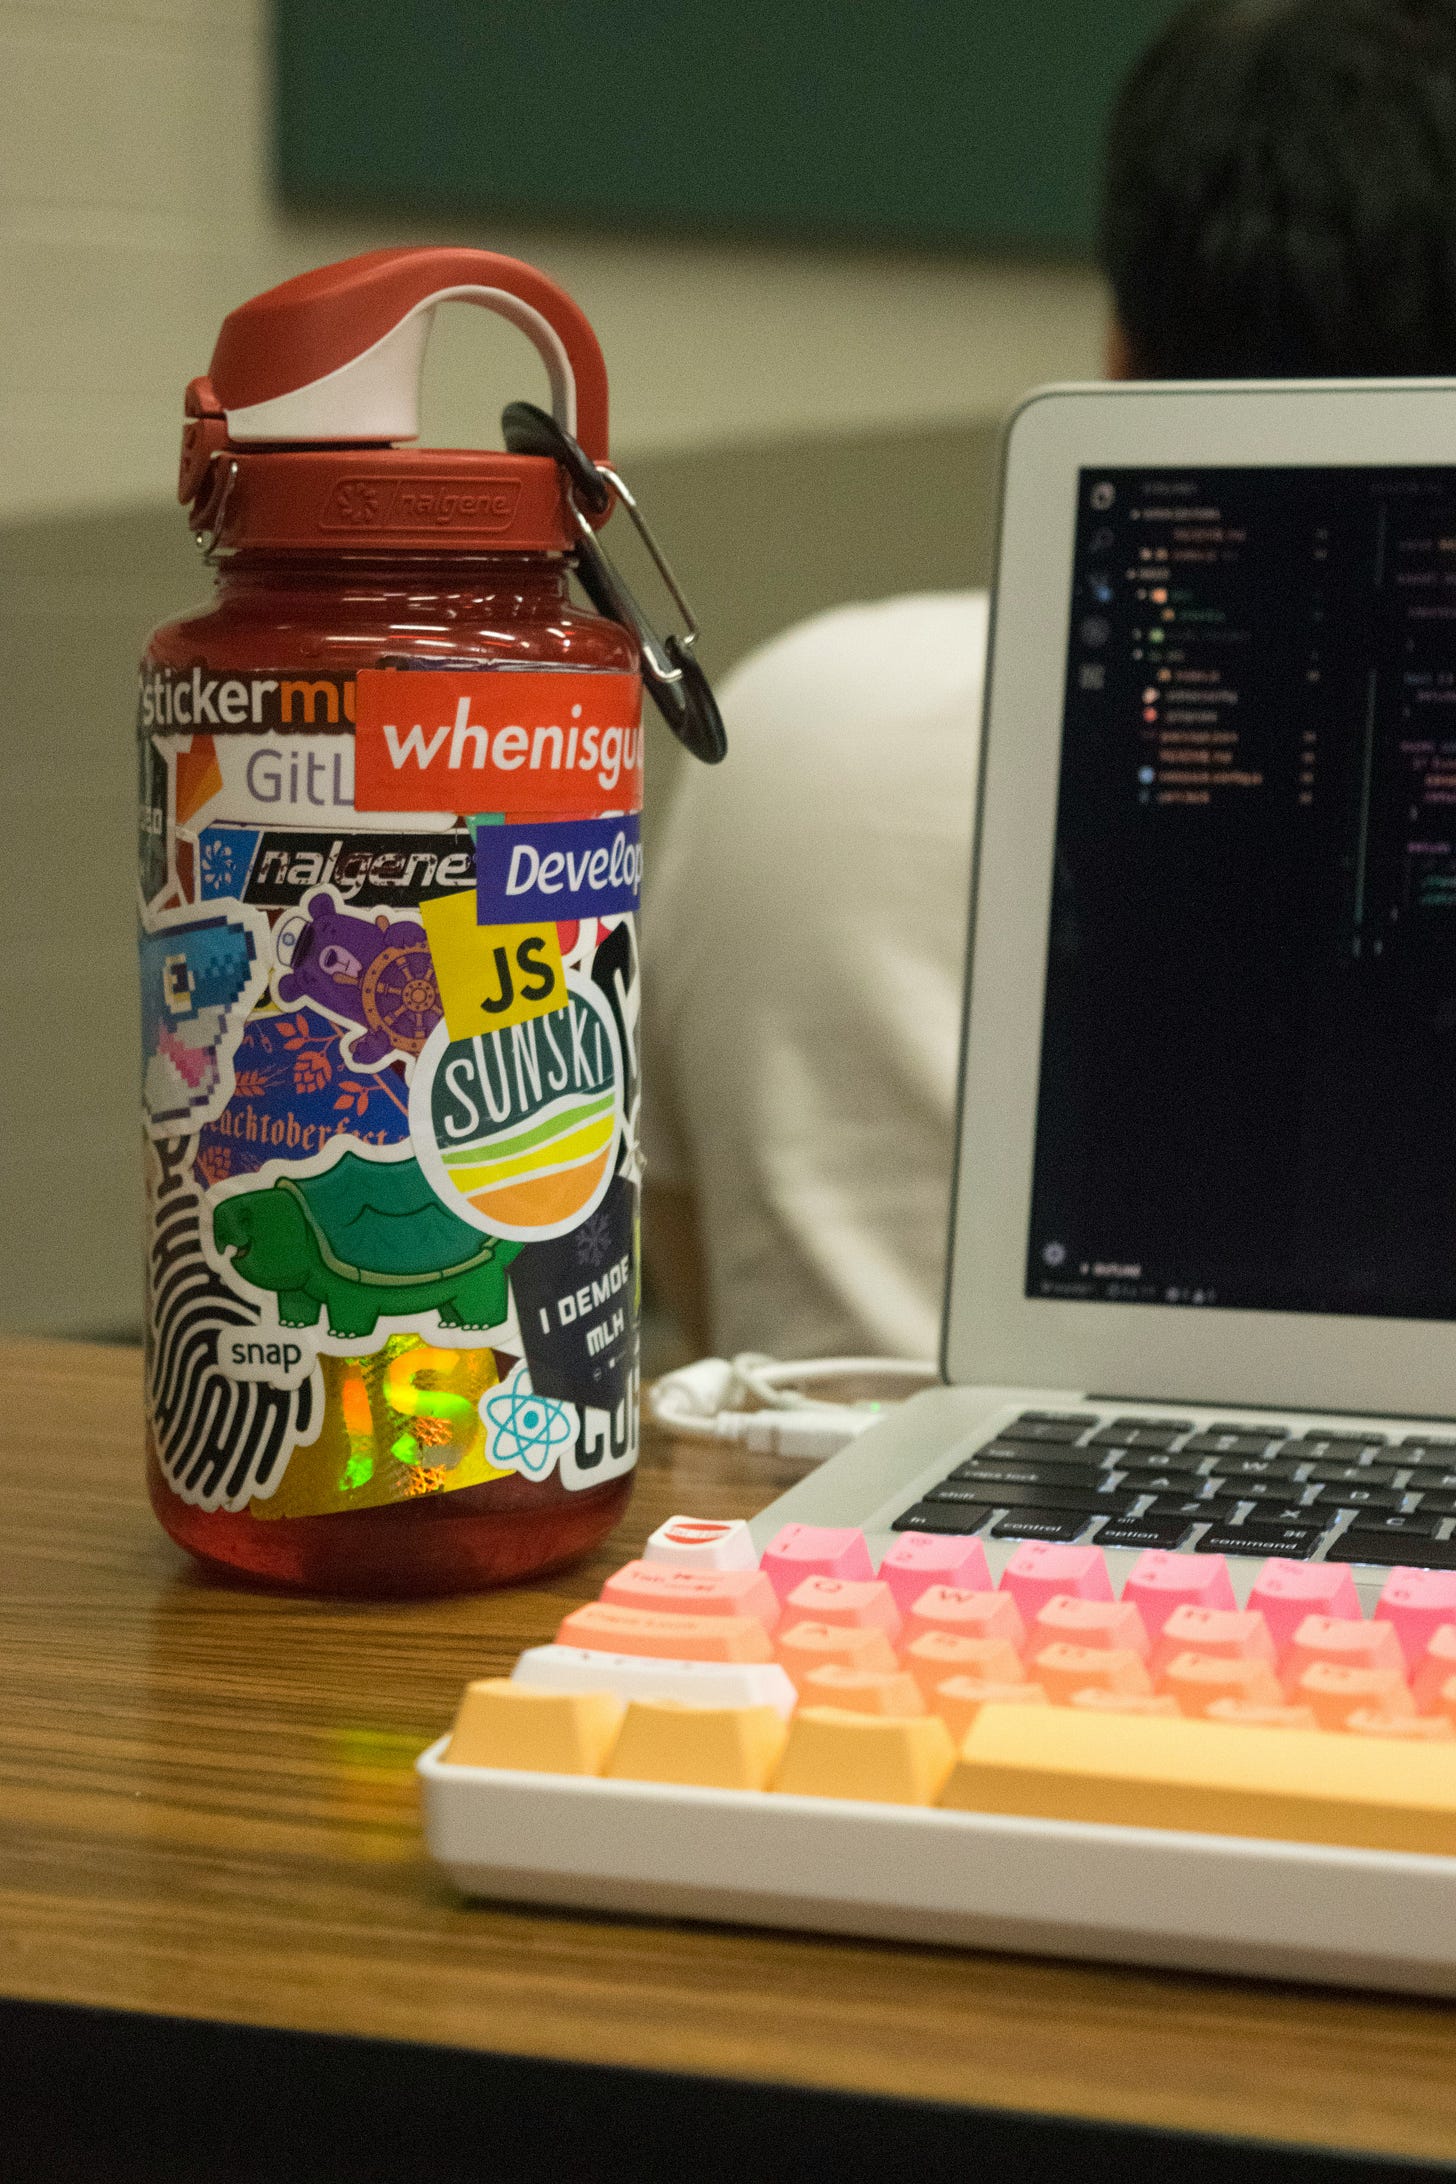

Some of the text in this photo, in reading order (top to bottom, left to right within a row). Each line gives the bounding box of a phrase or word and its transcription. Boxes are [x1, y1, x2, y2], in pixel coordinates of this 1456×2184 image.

[256, 840, 477, 900] nalgene
[480, 937, 555, 1013] JS
[444, 1000, 604, 1138] SUNSKI
[539, 1307, 550, 1335] I
[586, 1308, 625, 1357] MLH
[231, 1341, 302, 1372] snap
[1003, 1520, 1062, 1533] control
[1105, 1529, 1160, 1541] option
[1209, 1537, 1298, 1551] command
